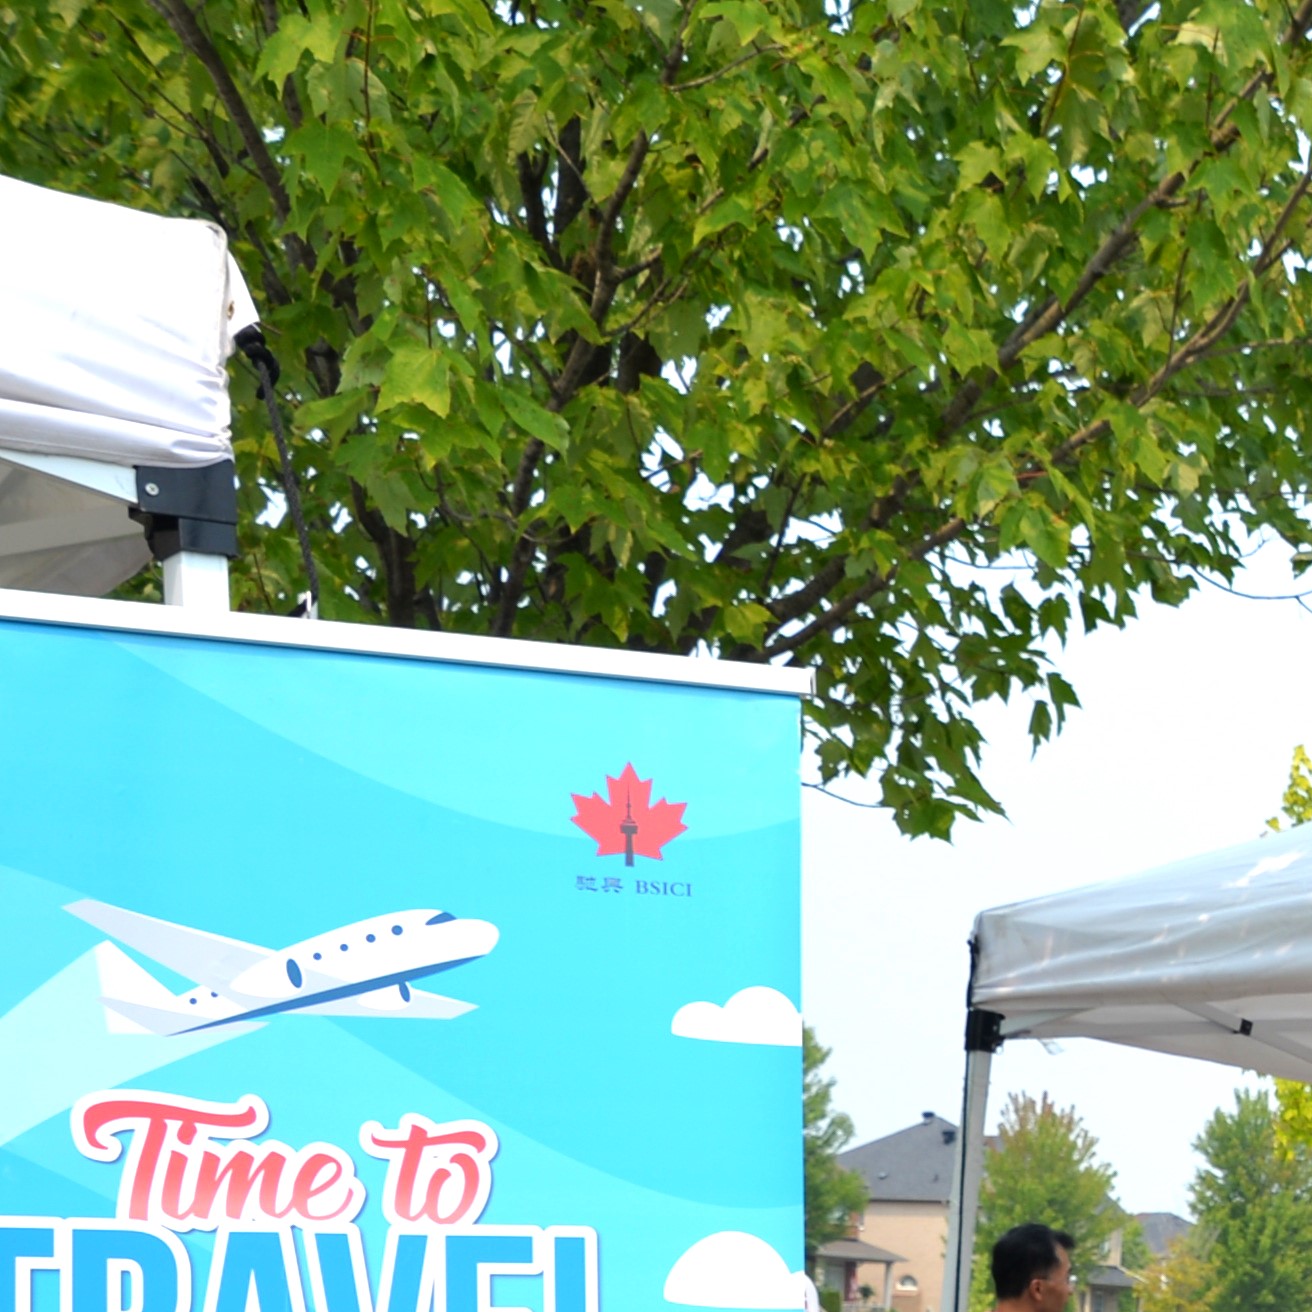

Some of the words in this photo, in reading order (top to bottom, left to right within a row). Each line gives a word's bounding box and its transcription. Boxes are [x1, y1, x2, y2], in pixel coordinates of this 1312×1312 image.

[635, 880, 692, 897] BSICI
[82, 1098, 357, 1222] Time
[370, 1122, 488, 1226] to
